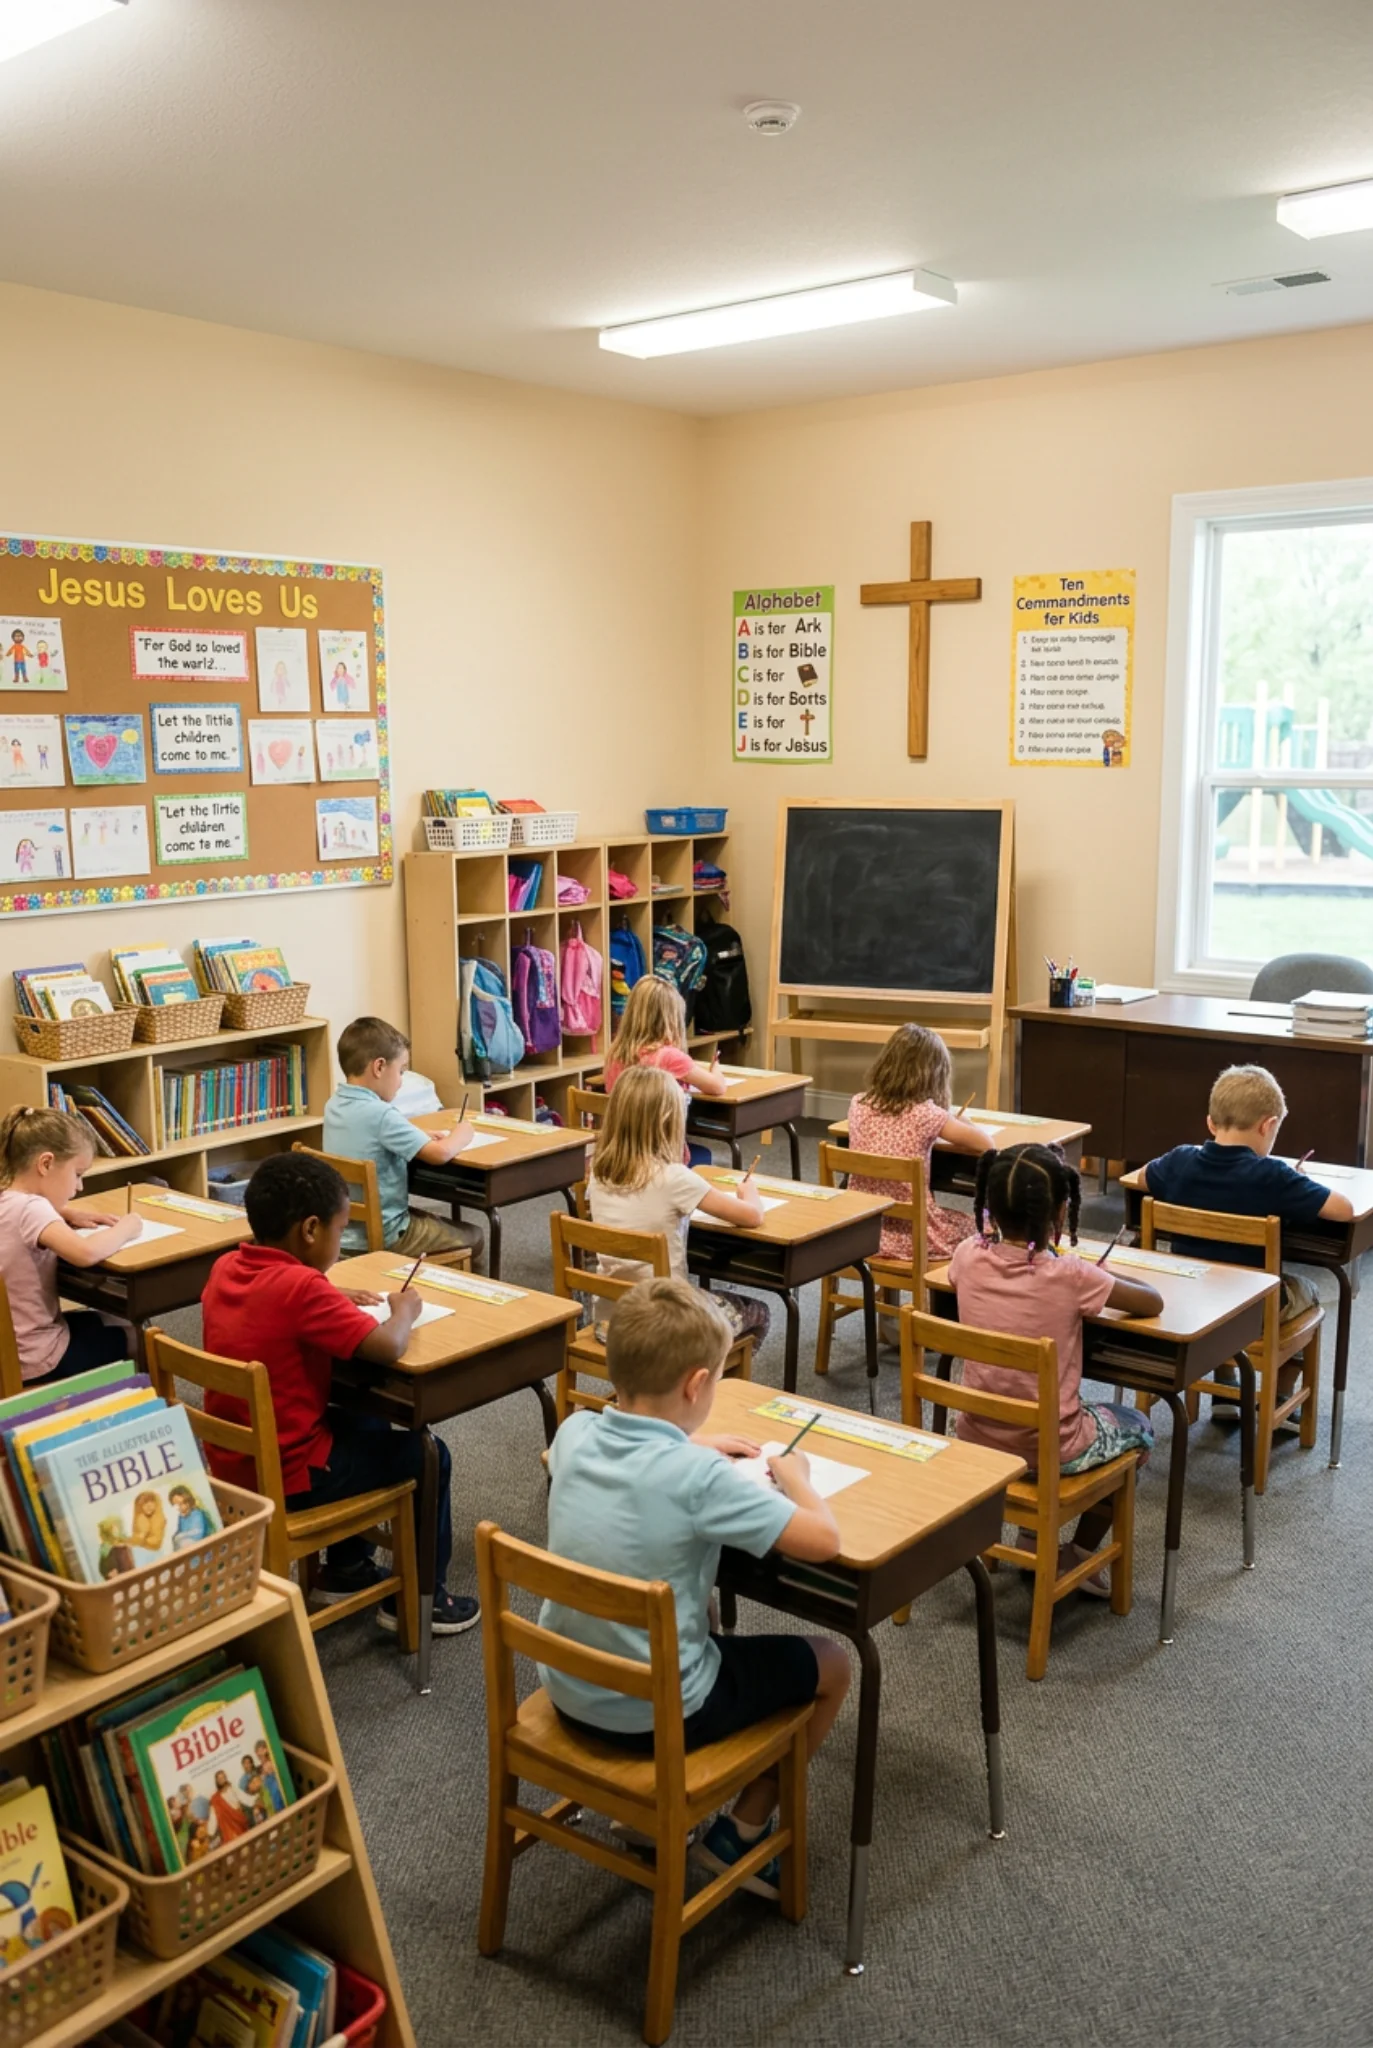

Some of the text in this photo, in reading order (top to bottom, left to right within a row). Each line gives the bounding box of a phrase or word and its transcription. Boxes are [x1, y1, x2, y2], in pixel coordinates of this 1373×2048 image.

[1060, 578, 1084, 590] Ten
[38, 568, 318, 619] Jesus Loves Us
[1068, 611, 1100, 624] Kids
[737, 619, 751, 637] A
[754, 622, 764, 636] is
[795, 617, 822, 634] Ark
[168, 639, 191, 652] God
[211, 640, 240, 654] loved
[738, 642, 749, 659] B
[753, 645, 763, 659] is
[789, 642, 827, 658] Bible
[737, 665, 749, 683] C
[753, 669, 763, 682] is
[737, 689, 750, 706] D
[753, 692, 763, 706] is
[158, 714, 178, 727] Let
[182, 714, 202, 727] the
[738, 711, 748, 729] E
[753, 716, 763, 729] is
[737, 735, 747, 752] J
[750, 738, 760, 751] is
[785, 737, 827, 753] Jesus
[195, 750, 207, 761] to
[80, 1440, 183, 1504] BIBLE
[170, 1715, 245, 1771] Bible
